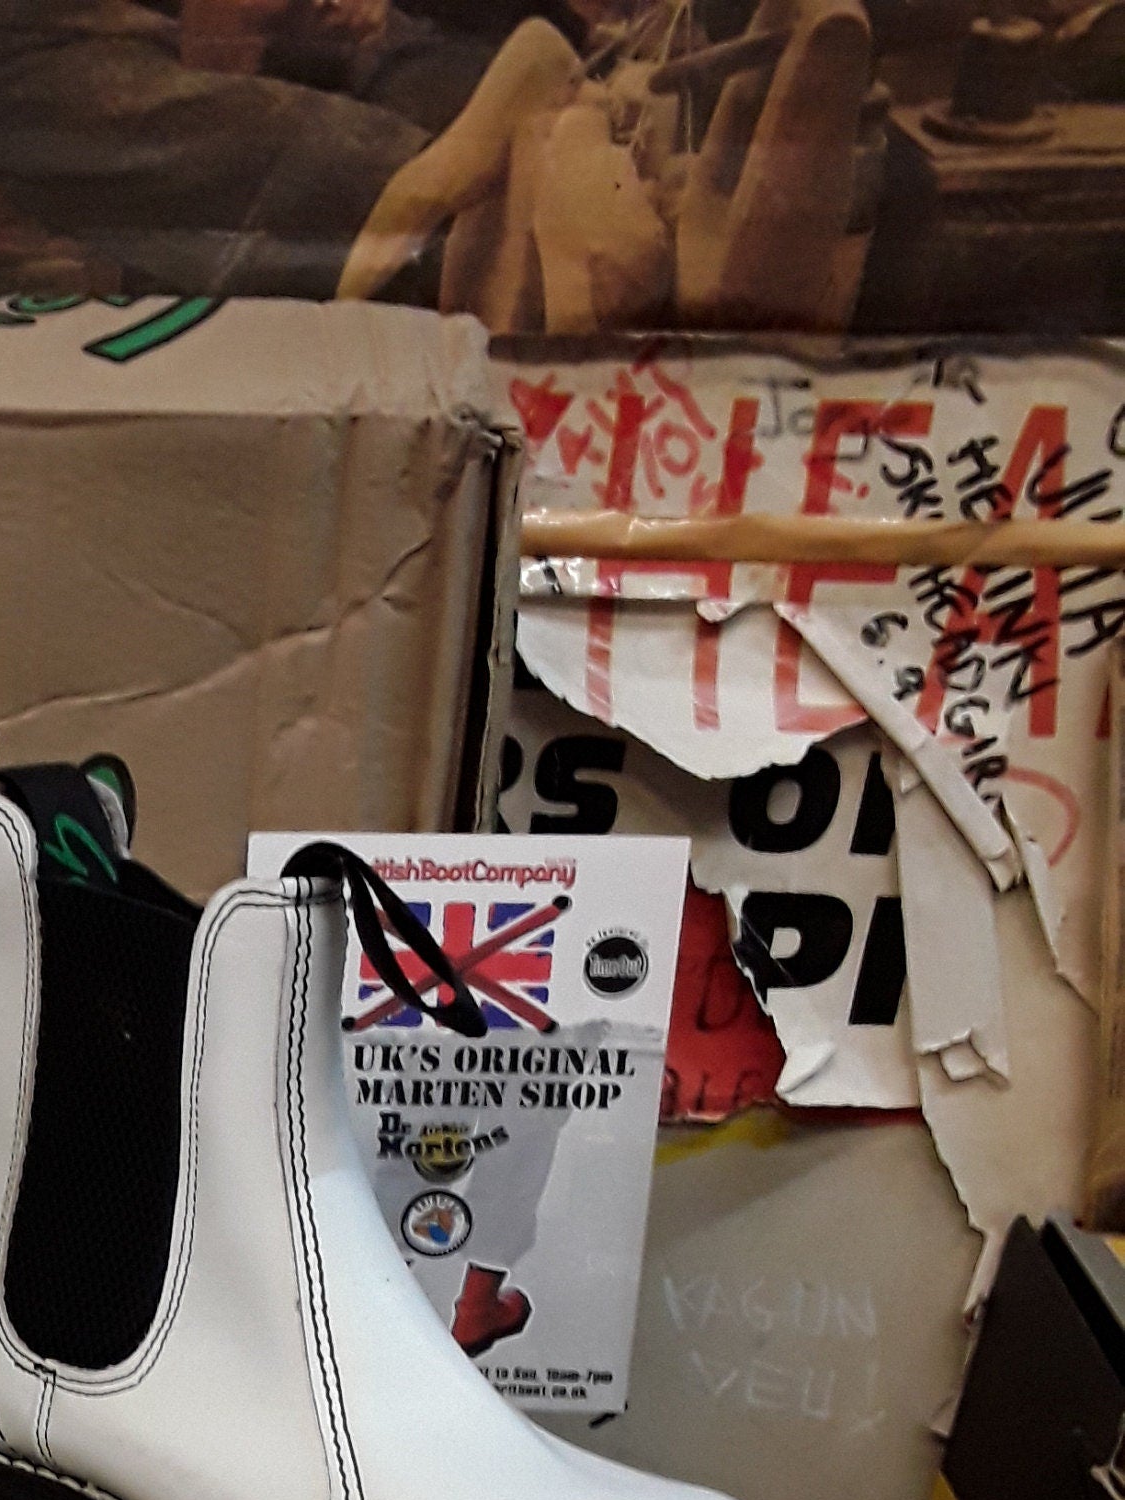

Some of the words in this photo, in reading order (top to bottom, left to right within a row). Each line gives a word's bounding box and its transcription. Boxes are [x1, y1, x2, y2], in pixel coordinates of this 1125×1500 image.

[354, 1045, 440, 1073] UK'S
[453, 1045, 636, 1078] ORIGINAL
[356, 1078, 507, 1107] MARTEN
[519, 1080, 622, 1110] SHOP
